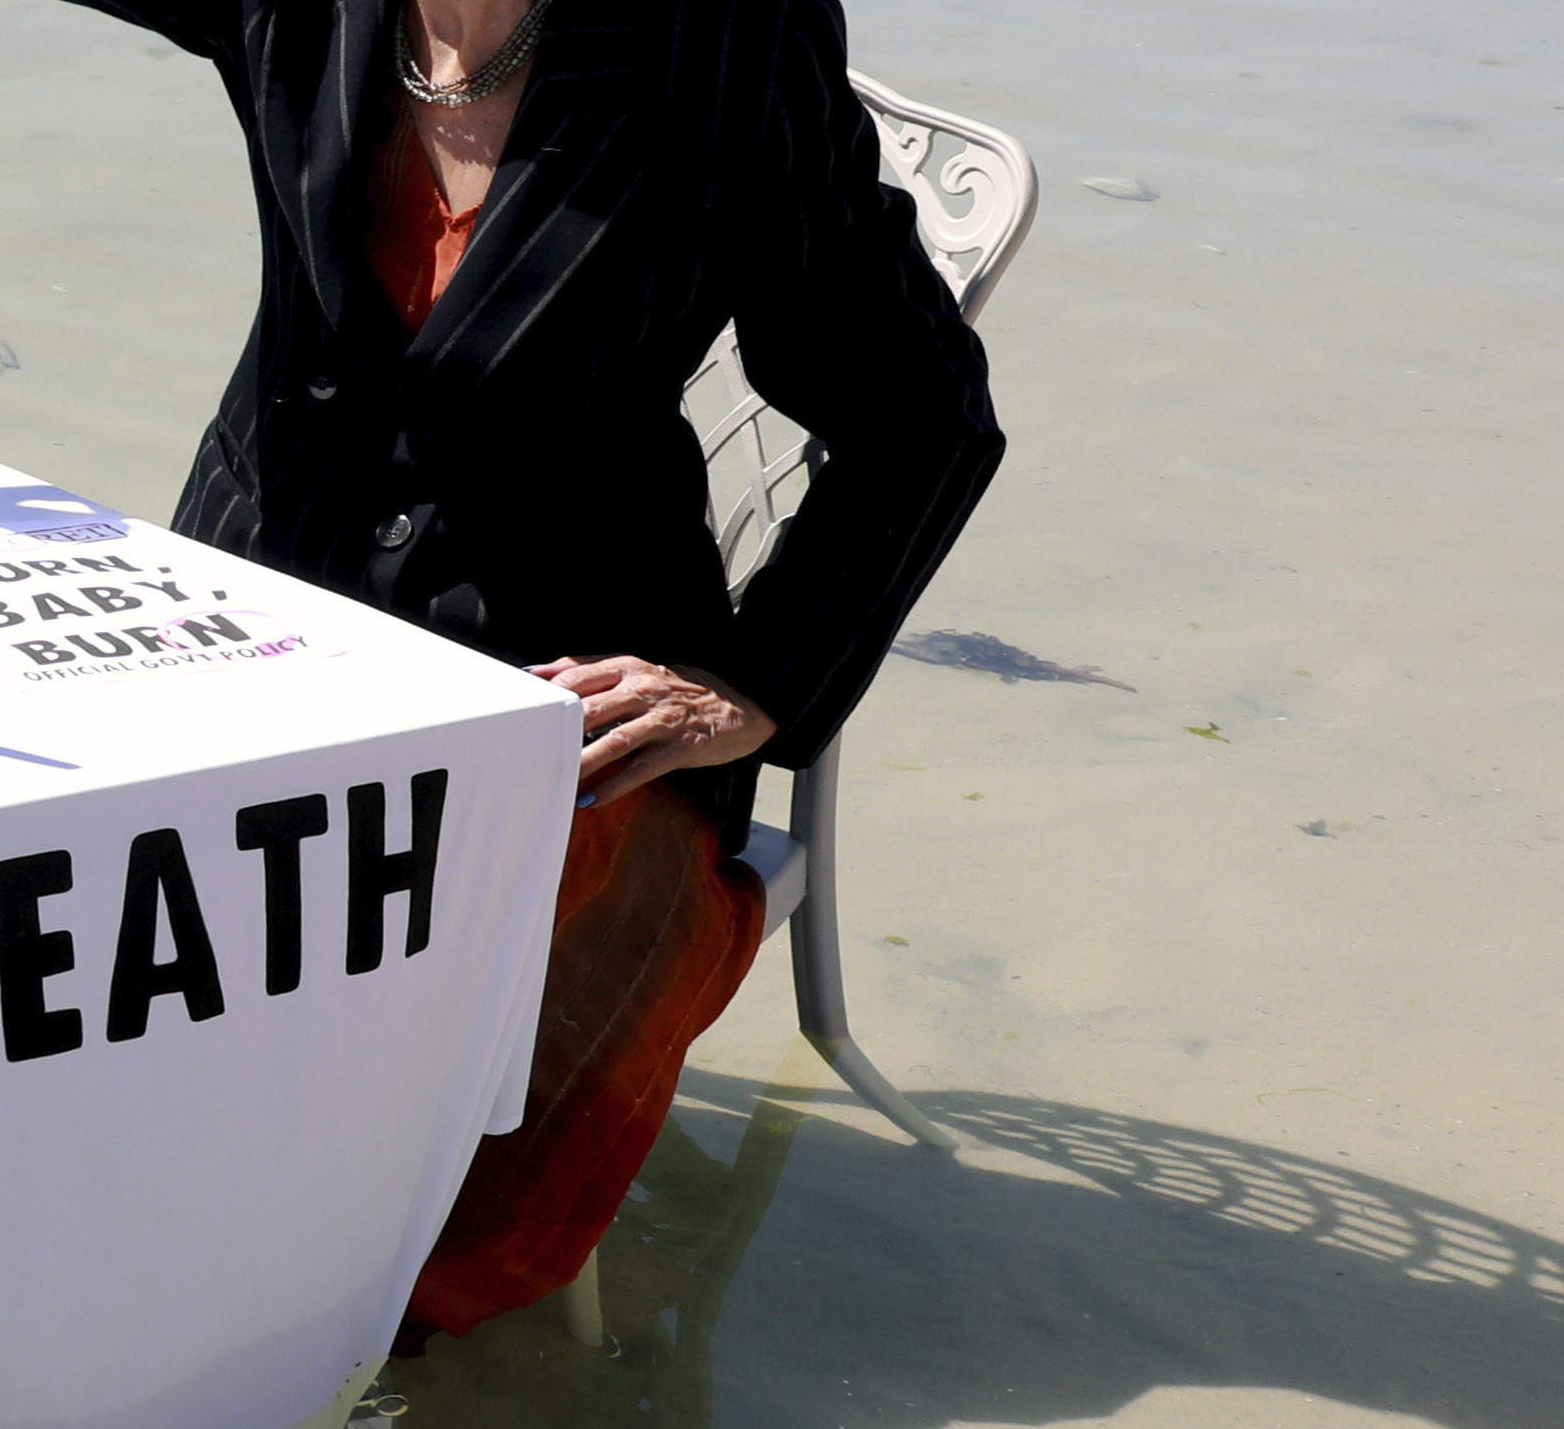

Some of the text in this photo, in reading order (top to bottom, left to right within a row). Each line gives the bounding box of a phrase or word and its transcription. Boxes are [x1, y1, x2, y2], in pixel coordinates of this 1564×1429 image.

[10, 612, 253, 666] BURN
[22, 661, 135, 682] OFFICIAL
[218, 635, 310, 661] POLICY
